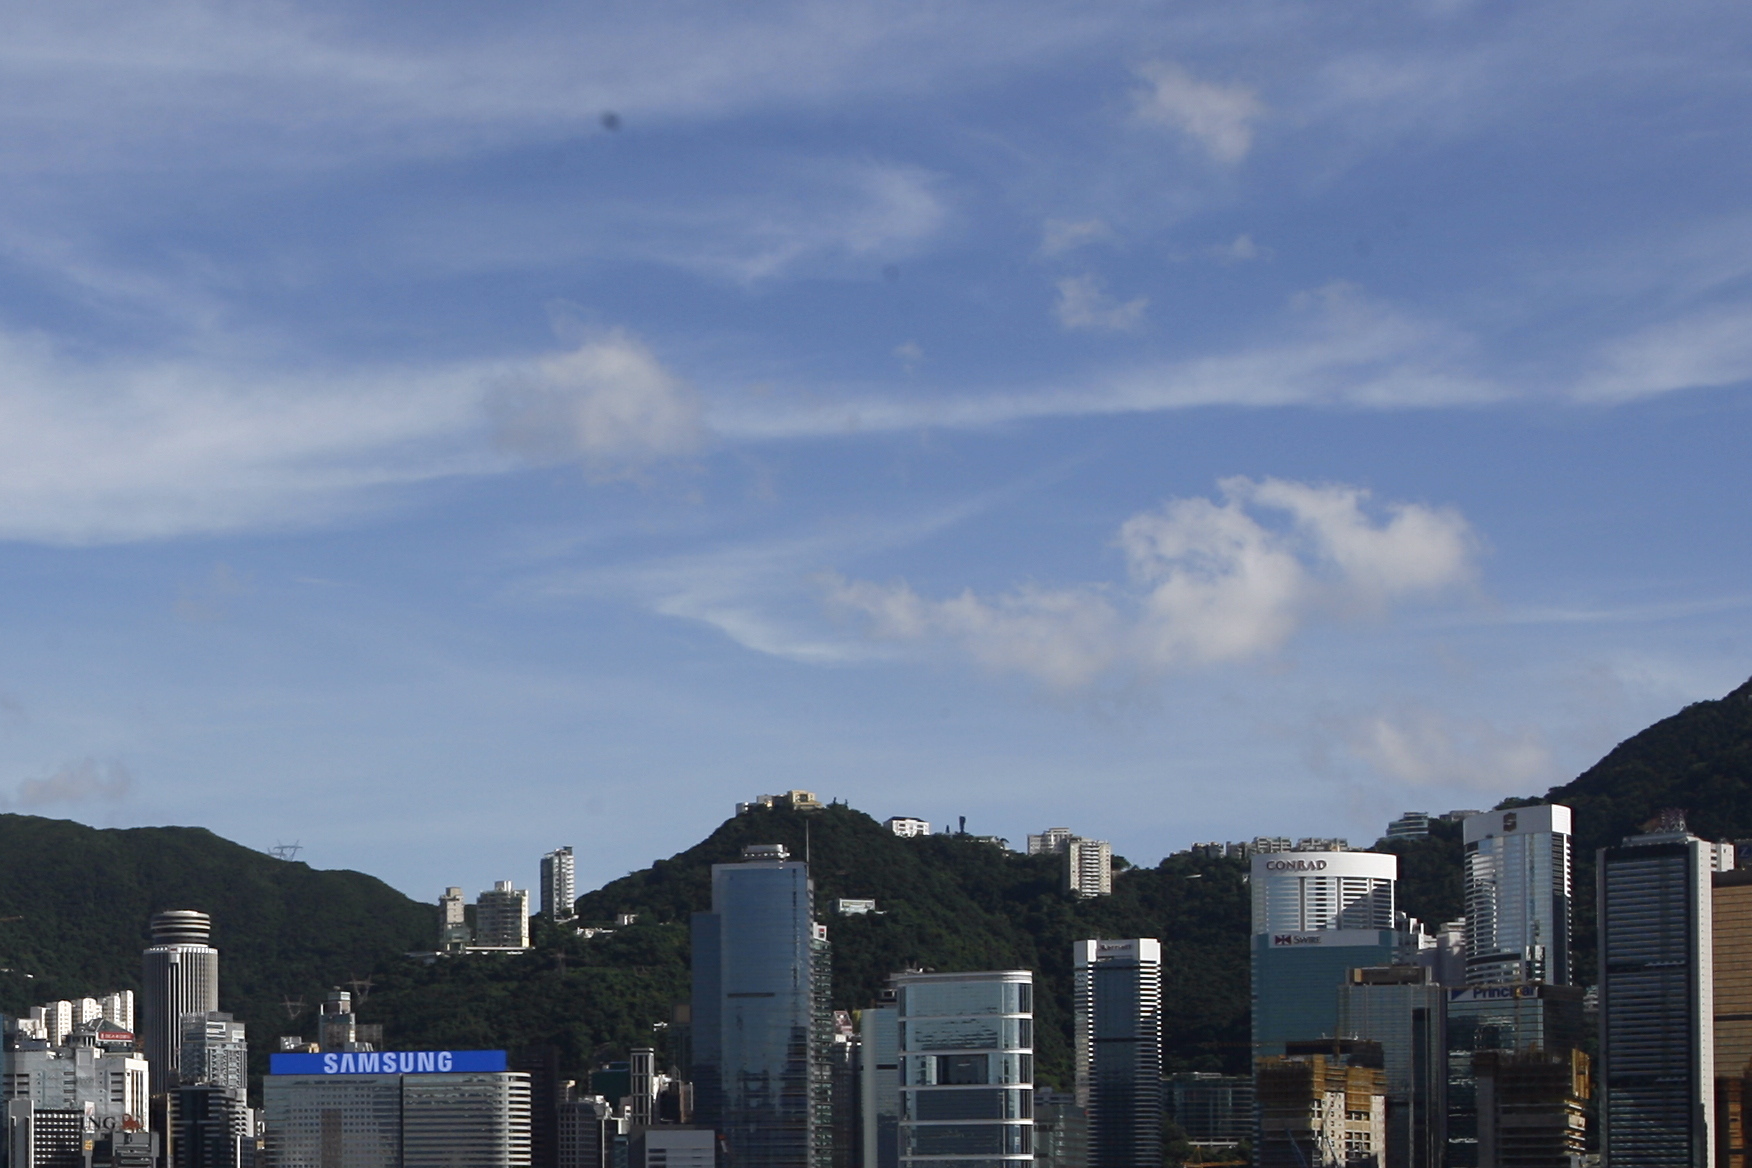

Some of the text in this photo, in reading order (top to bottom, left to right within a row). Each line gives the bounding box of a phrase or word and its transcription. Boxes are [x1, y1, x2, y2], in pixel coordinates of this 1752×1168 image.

[1266, 860, 1327, 871] CONRAD
[1474, 986, 1535, 999] Princial
[323, 1051, 453, 1073] SAMSUNG
[80, 1116, 116, 1131] ING
